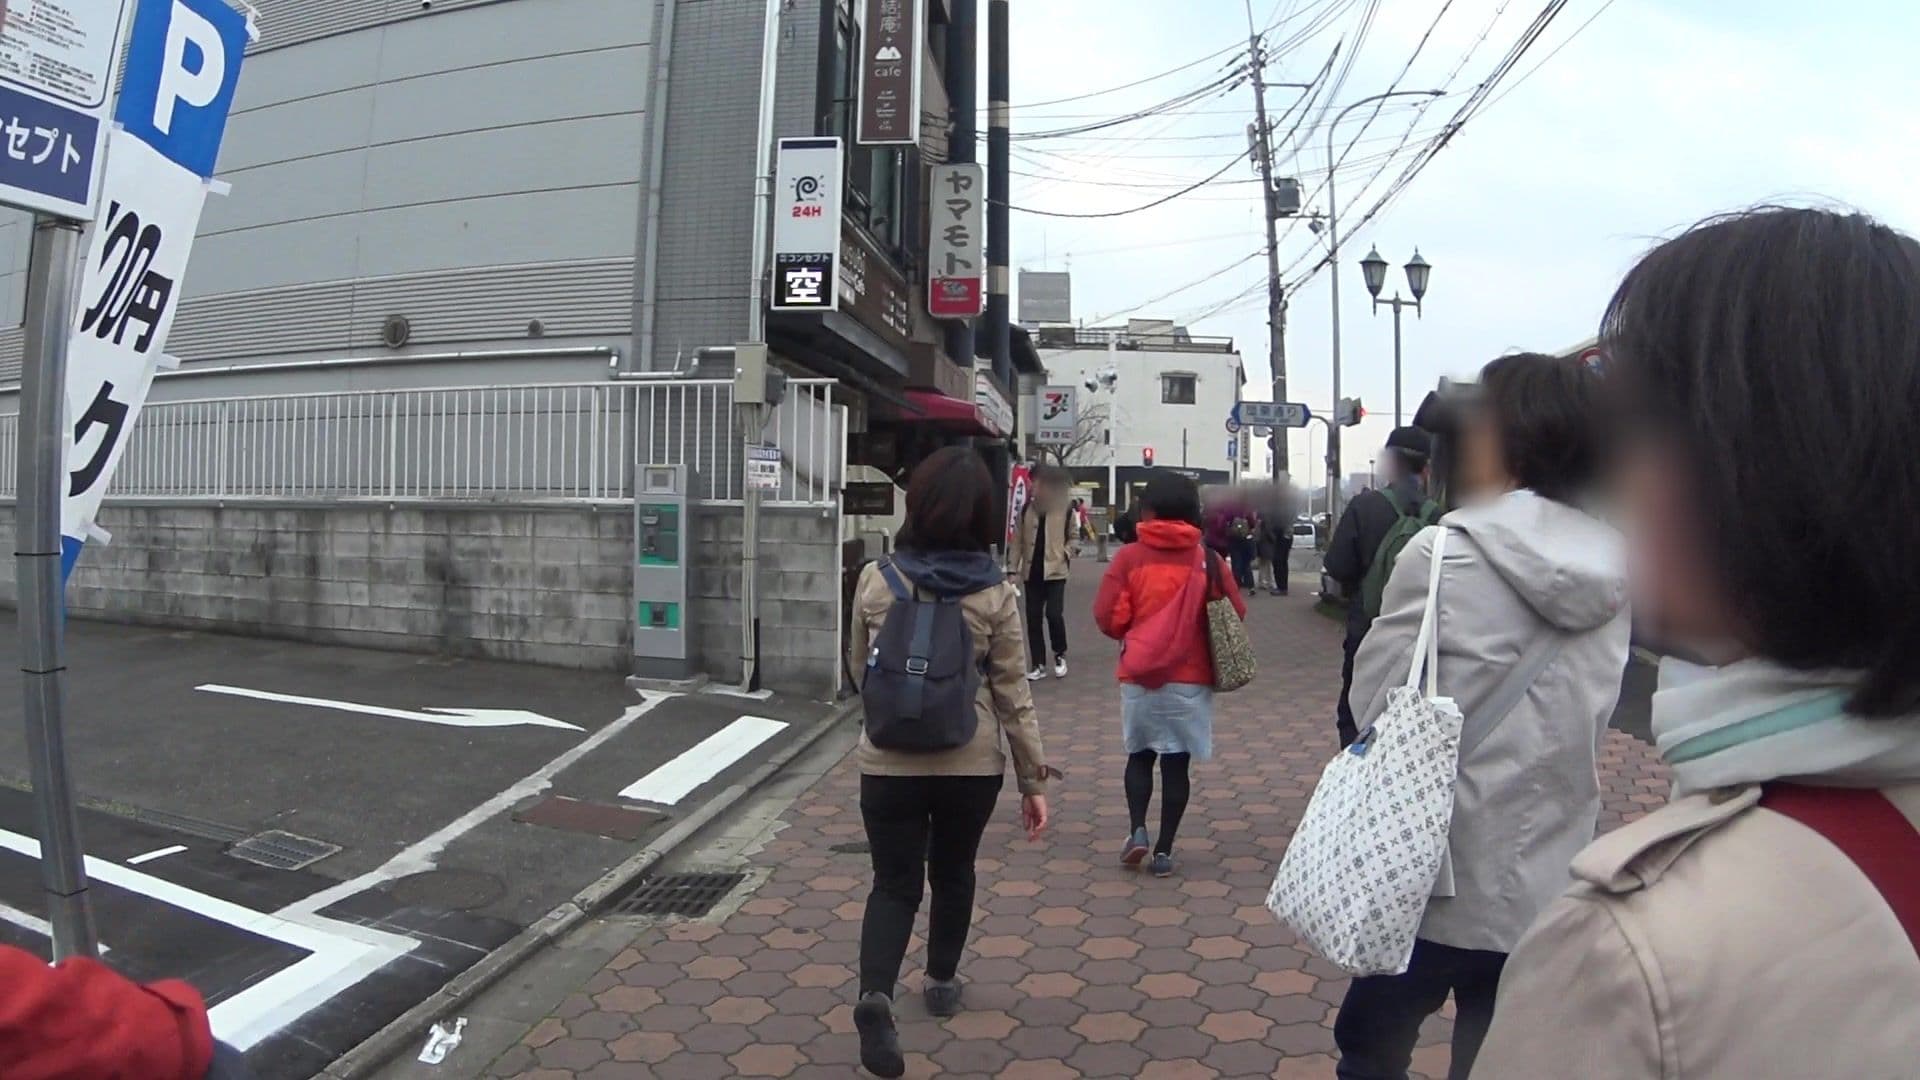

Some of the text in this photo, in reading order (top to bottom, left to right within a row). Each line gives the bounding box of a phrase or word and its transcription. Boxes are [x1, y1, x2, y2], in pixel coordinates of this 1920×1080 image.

[153, 0, 225, 135] P
[874, 66, 902, 77] cafe
[0, 116, 81, 173] セプト
[791, 205, 822, 218] 24H
[944, 170, 973, 276] ヤマモト
[785, 267, 823, 304] 空
